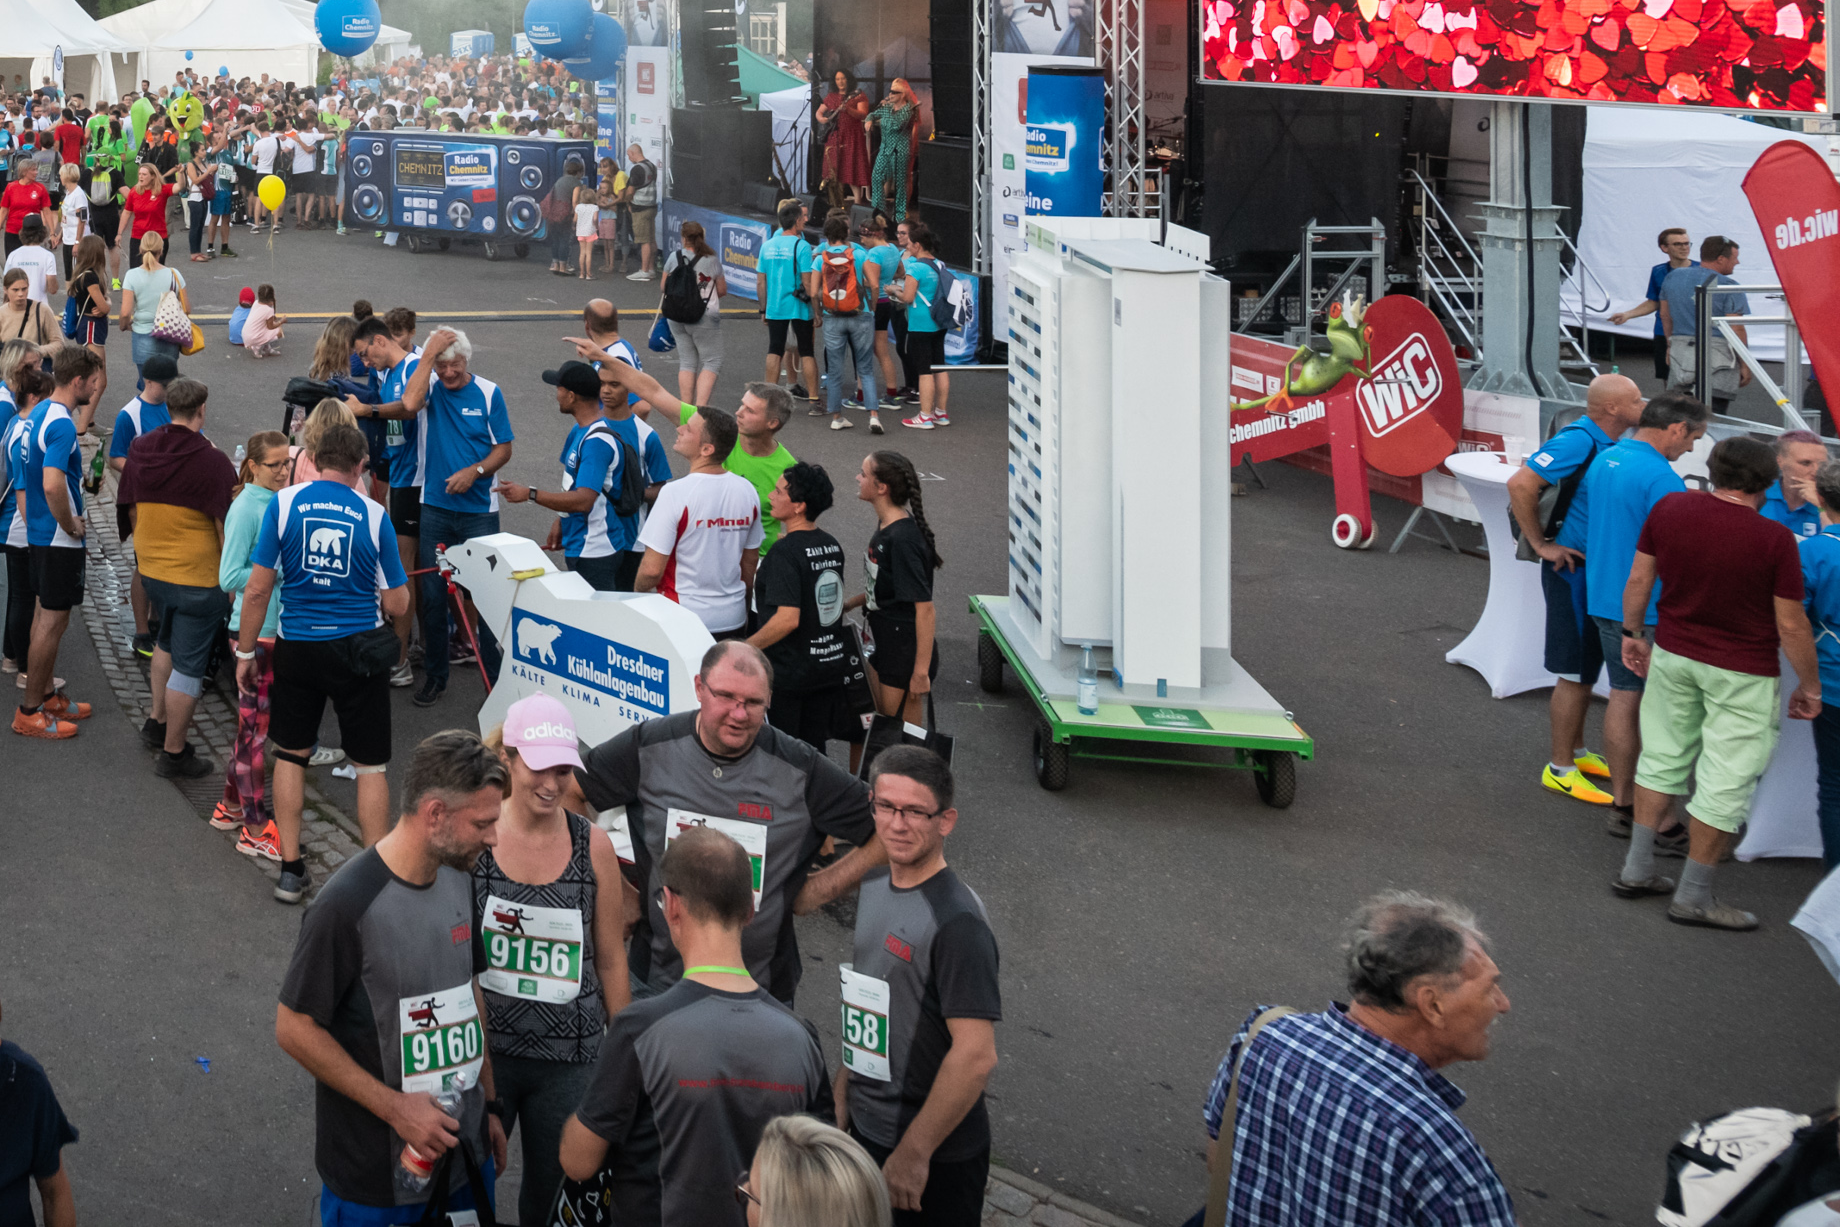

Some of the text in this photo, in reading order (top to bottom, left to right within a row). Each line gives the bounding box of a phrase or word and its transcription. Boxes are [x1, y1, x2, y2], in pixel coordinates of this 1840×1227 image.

[1026, 129, 1046, 142] adio
[1026, 144, 1059, 156] emnitz
[399, 162, 443, 175] CHEMNITZ
[449, 164, 488, 174] Chemnitz
[454, 156, 479, 165] Radio
[1025, 192, 1053, 211] eine
[729, 231, 751, 250] Radio
[1362, 342, 1436, 430] WiC
[1230, 399, 1325, 444] chemnitz gmbh
[298, 502, 363, 522] Wir machen Euch
[707, 516, 750, 528] Minol
[308, 555, 343, 570] DKA
[313, 576, 331, 587] kalt
[608, 644, 664, 683] Dresdner
[567, 654, 665, 708] Kühlanlagenbau
[512, 664, 650, 722] KÄLTE KLIMA SERV
[738, 803, 772, 821] PMA
[451, 923, 471, 945] PMA
[490, 934, 570, 977] 9156
[885, 934, 911, 962] PMA
[413, 1021, 478, 1072] 9160
